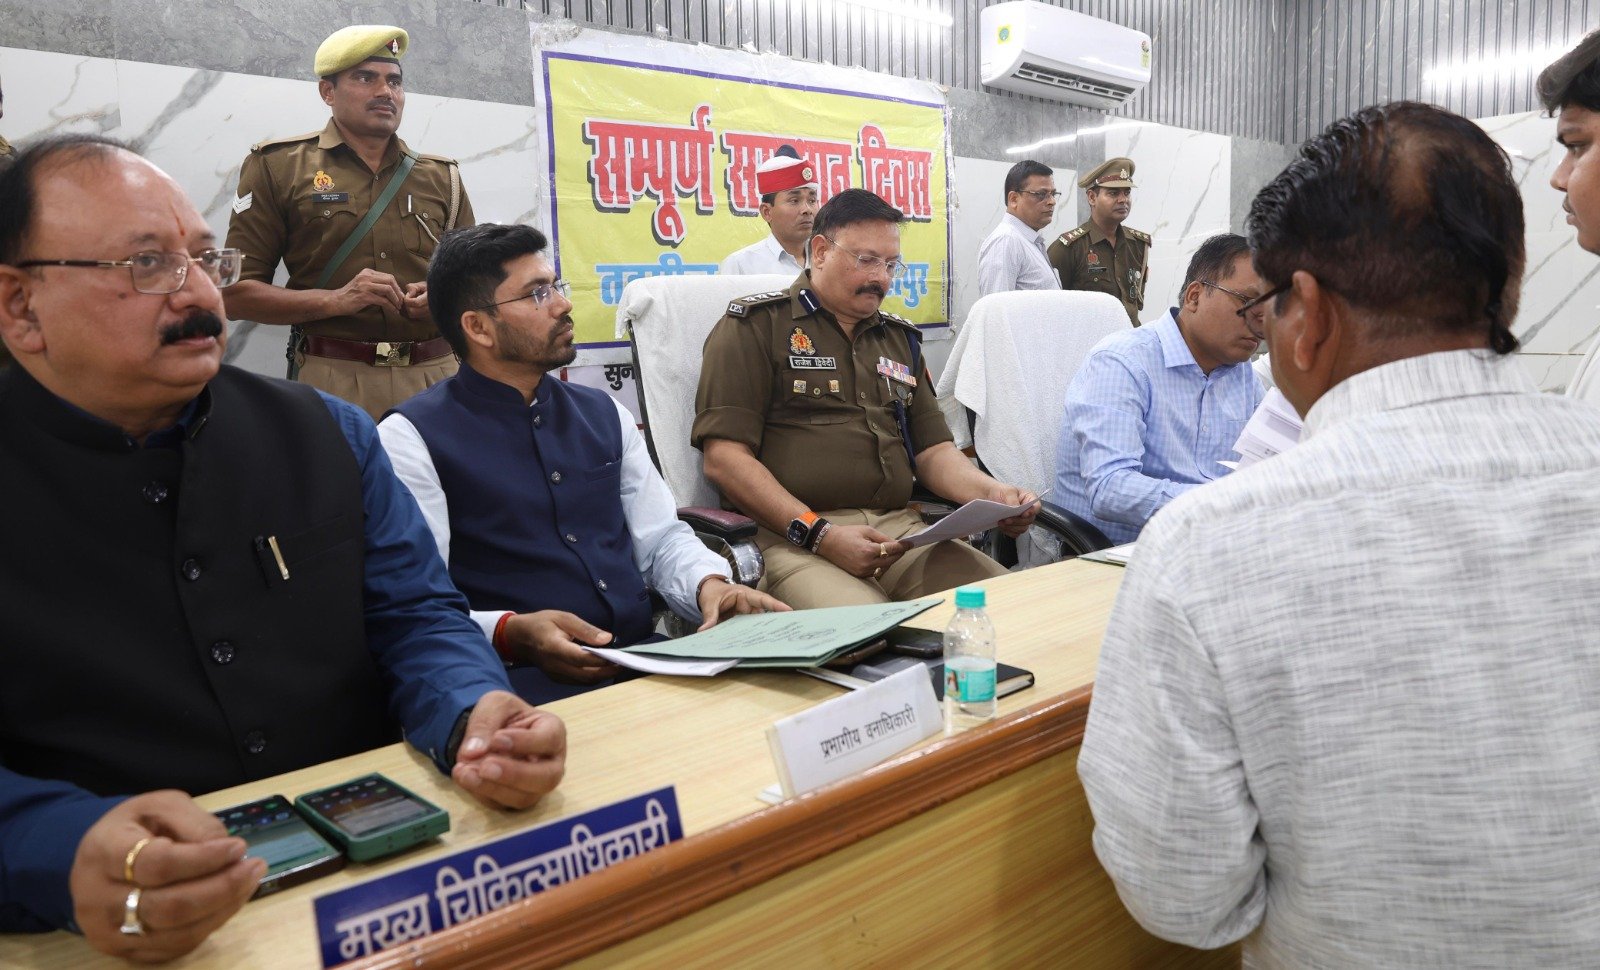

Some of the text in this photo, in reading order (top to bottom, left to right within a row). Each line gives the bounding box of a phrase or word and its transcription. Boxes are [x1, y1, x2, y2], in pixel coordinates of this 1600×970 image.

[583, 103, 716, 246] सम्पूर्ण
[857, 123, 933, 222] दिवस
[603, 363, 635, 391] सुन
[820, 703, 916, 758] प्रभागीय वनाधिकारी
